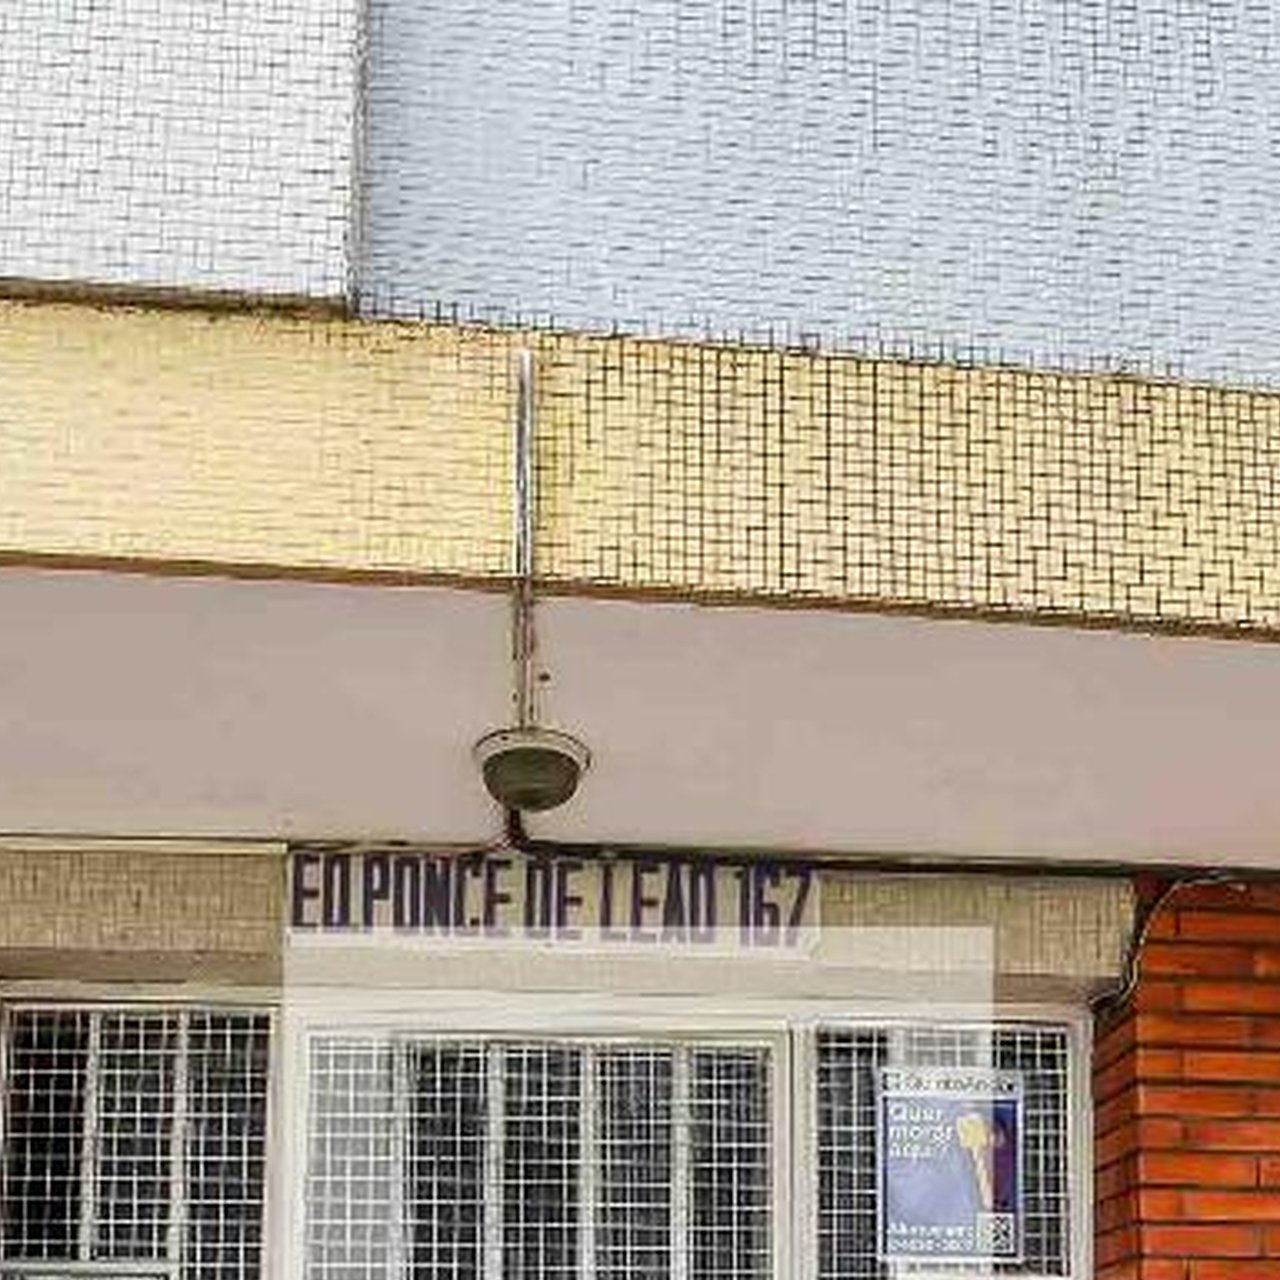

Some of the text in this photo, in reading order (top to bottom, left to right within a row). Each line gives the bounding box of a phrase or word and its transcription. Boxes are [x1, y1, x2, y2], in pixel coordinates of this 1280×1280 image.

[362, 854, 513, 938] PONCE
[524, 859, 585, 940] DE
[733, 862, 813, 947] 167
